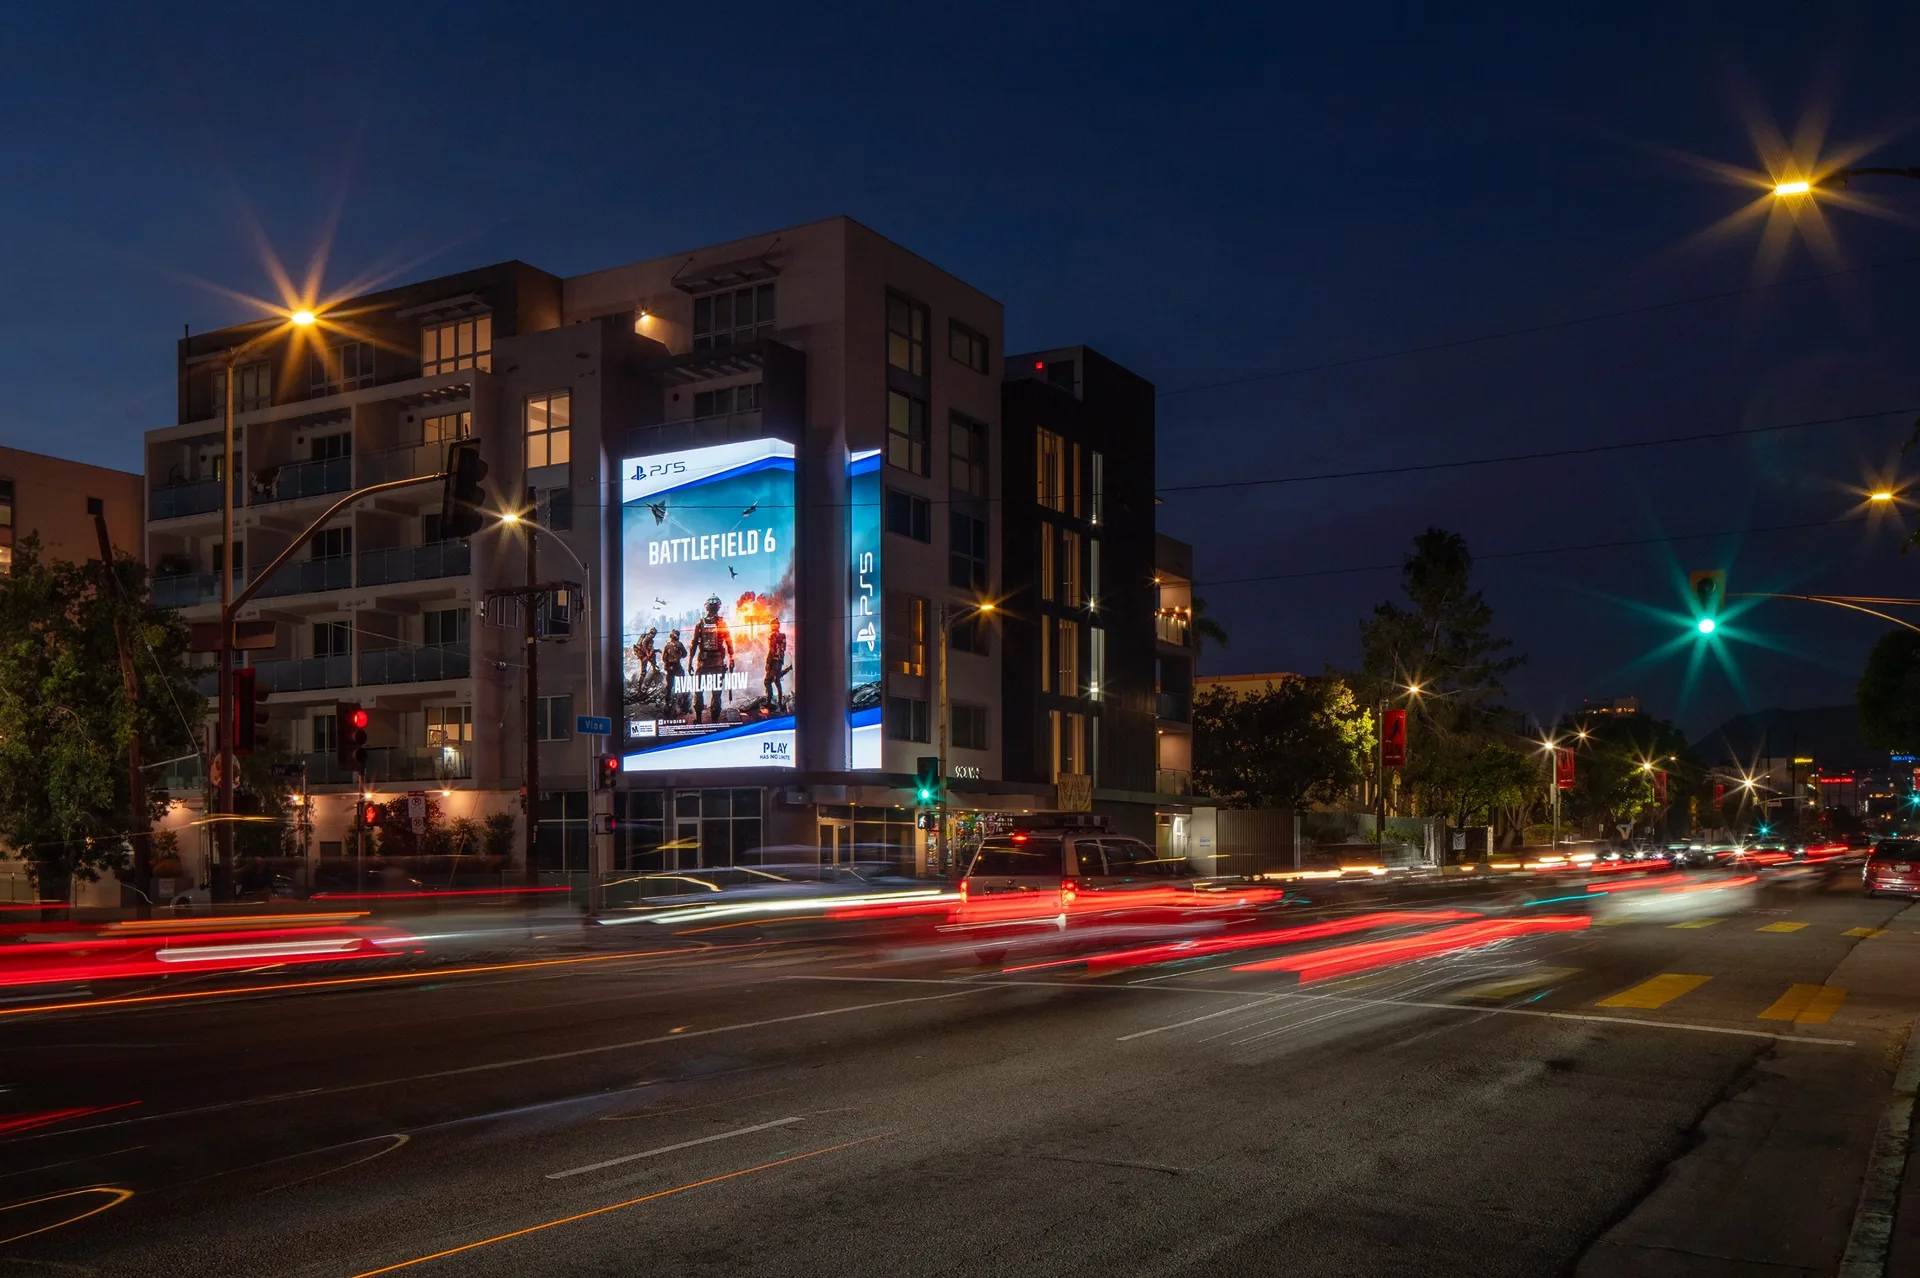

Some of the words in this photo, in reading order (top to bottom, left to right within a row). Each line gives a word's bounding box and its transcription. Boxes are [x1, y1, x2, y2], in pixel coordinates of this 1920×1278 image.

[650, 461, 685, 476] PS5
[649, 529, 758, 566] BATTLEFIELD
[764, 527, 776, 553] 6
[860, 551, 873, 616] PS5
[674, 673, 723, 693] AVAILABLE
[724, 671, 749, 690] NOW
[585, 720, 604, 731] Vine
[631, 725, 639, 734] M
[763, 741, 788, 753] PLAY
